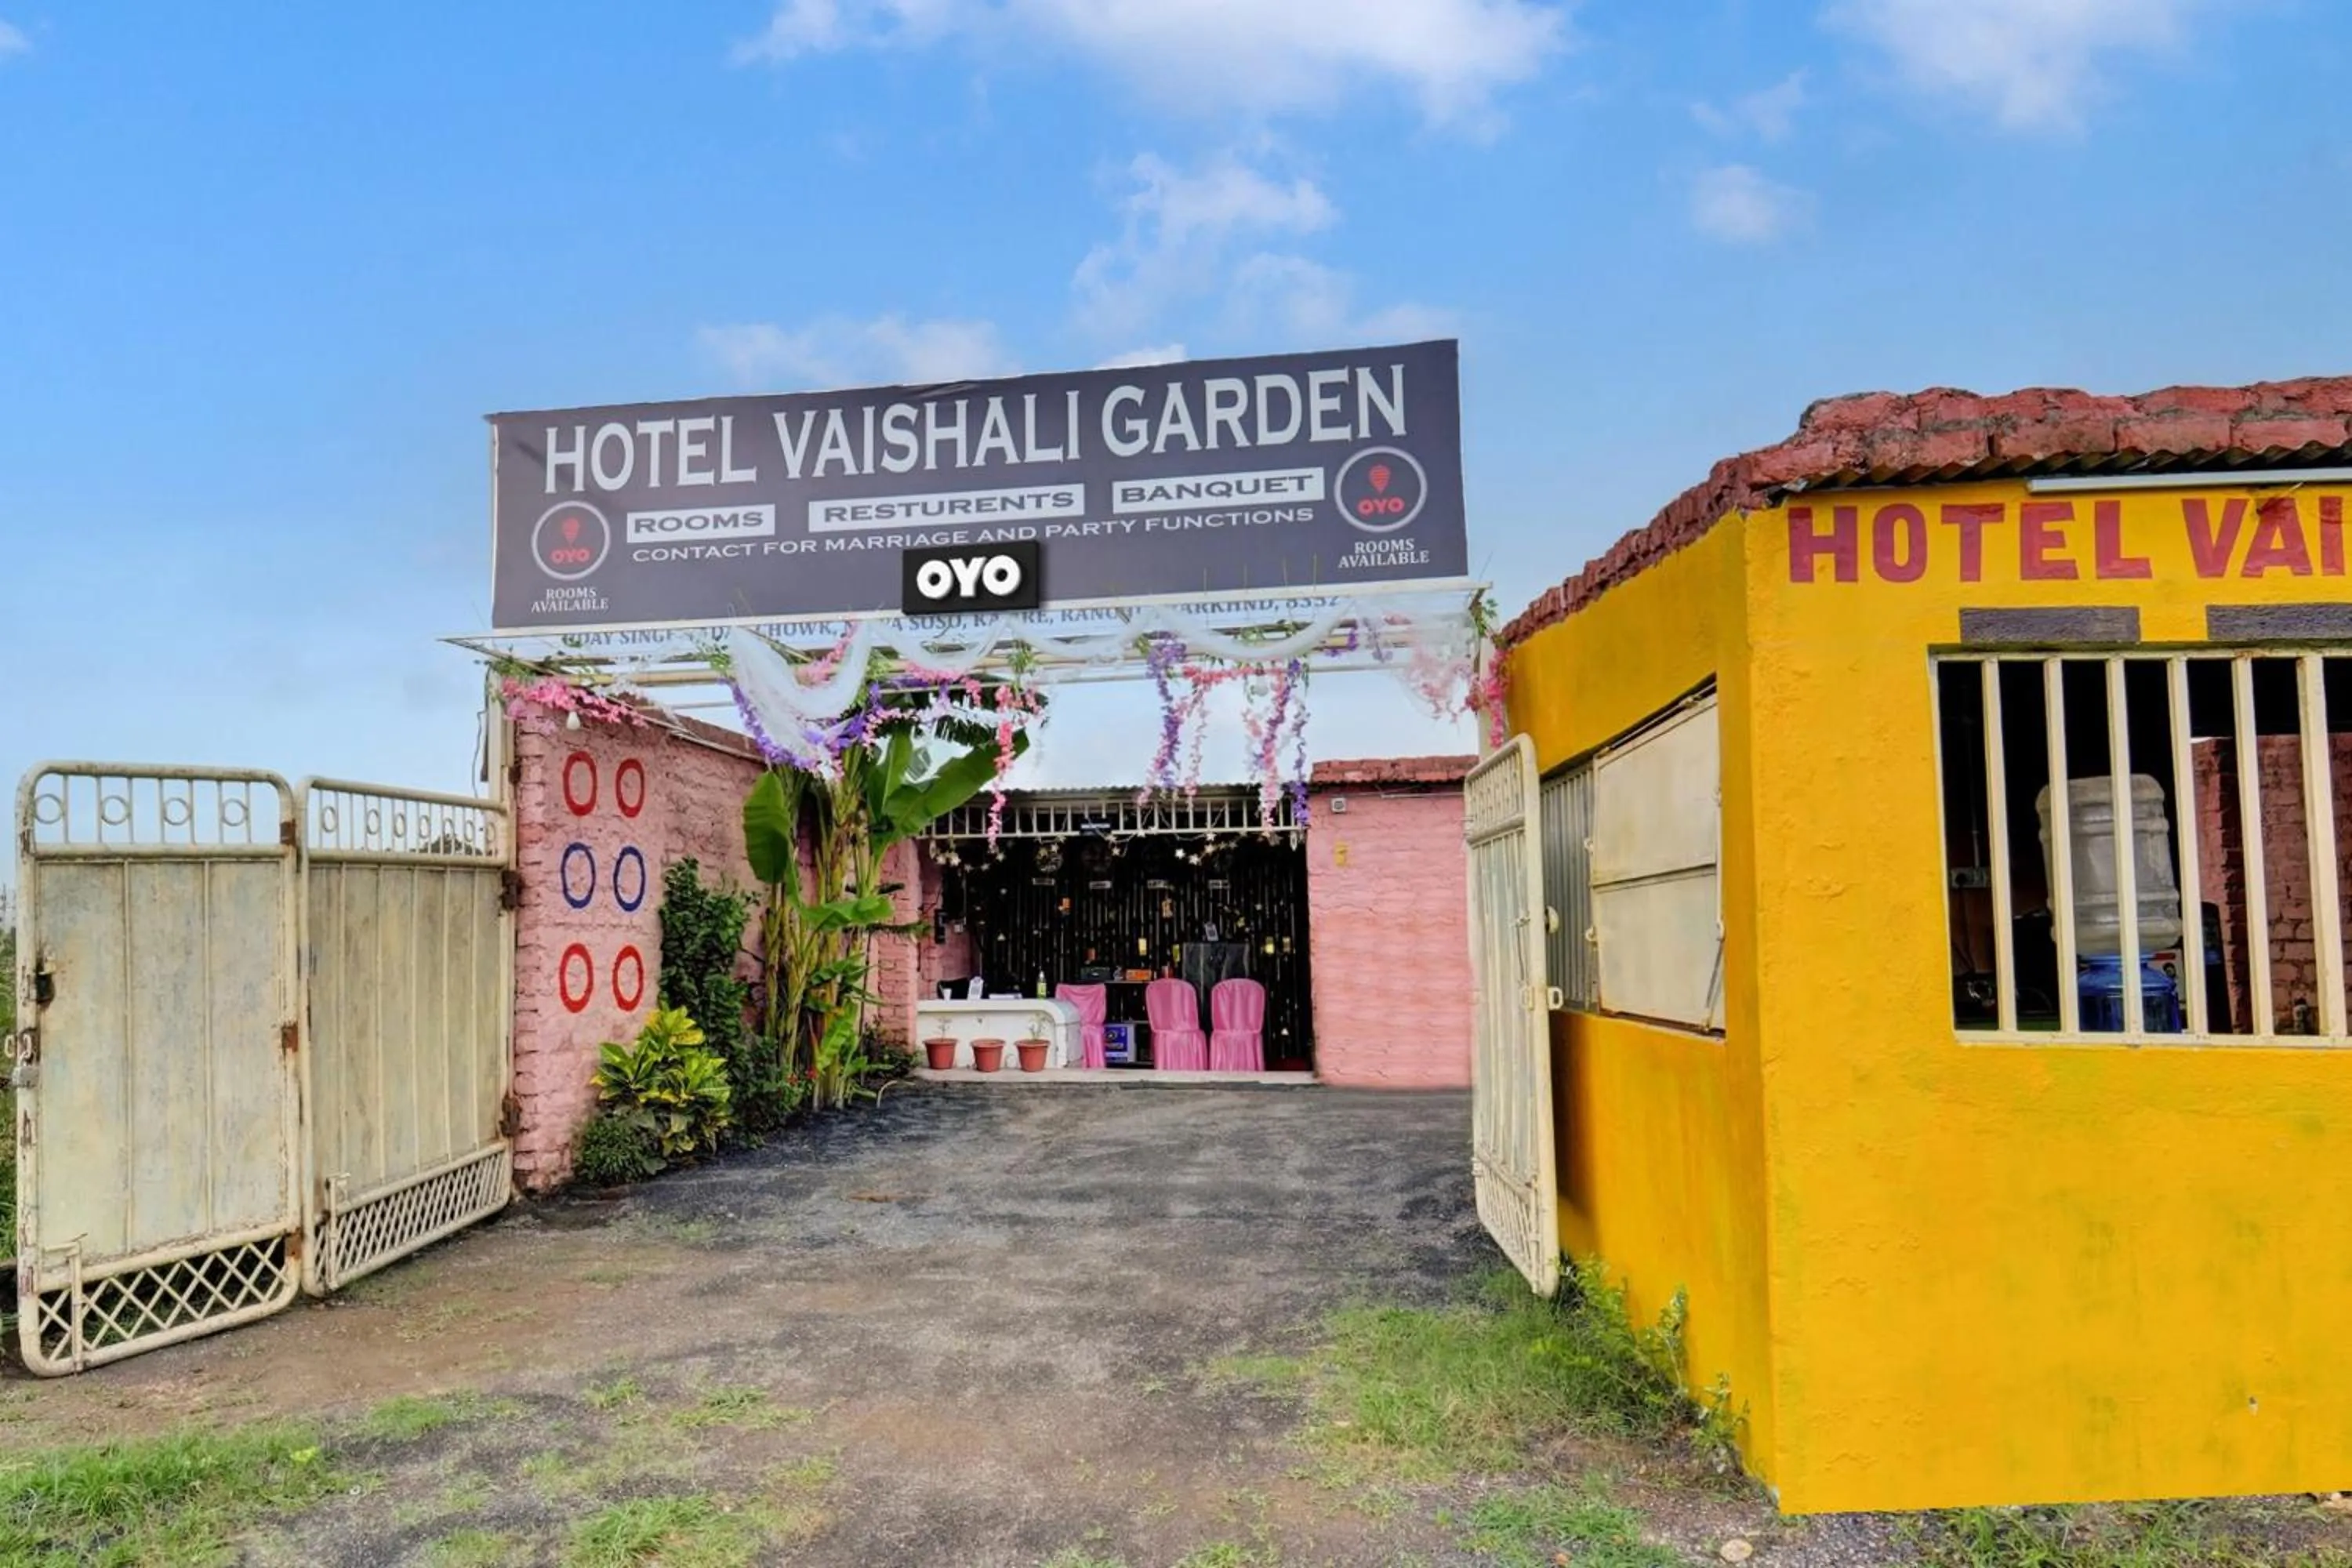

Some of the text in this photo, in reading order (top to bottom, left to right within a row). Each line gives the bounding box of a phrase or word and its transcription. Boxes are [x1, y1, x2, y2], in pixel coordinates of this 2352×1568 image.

[545, 365, 1407, 494] HOTEL VAISHALI GARDEN
[633, 474, 1314, 534] ROOMS RESTURENTS BANQUET
[1356, 496, 1406, 516] OYO
[632, 507, 1314, 563] CONTACT FOR MARRIAGE AND PARTY FUNCTIONS
[1788, 500, 2152, 584] HOTEL
[551, 549, 590, 564] OYO
[1354, 539, 1416, 554] ROOMS
[1339, 550, 1430, 569] AVAILABLE
[916, 554, 1022, 600] OYO
[546, 586, 597, 600] ROOMS
[531, 598, 610, 613] AVAILABLE
